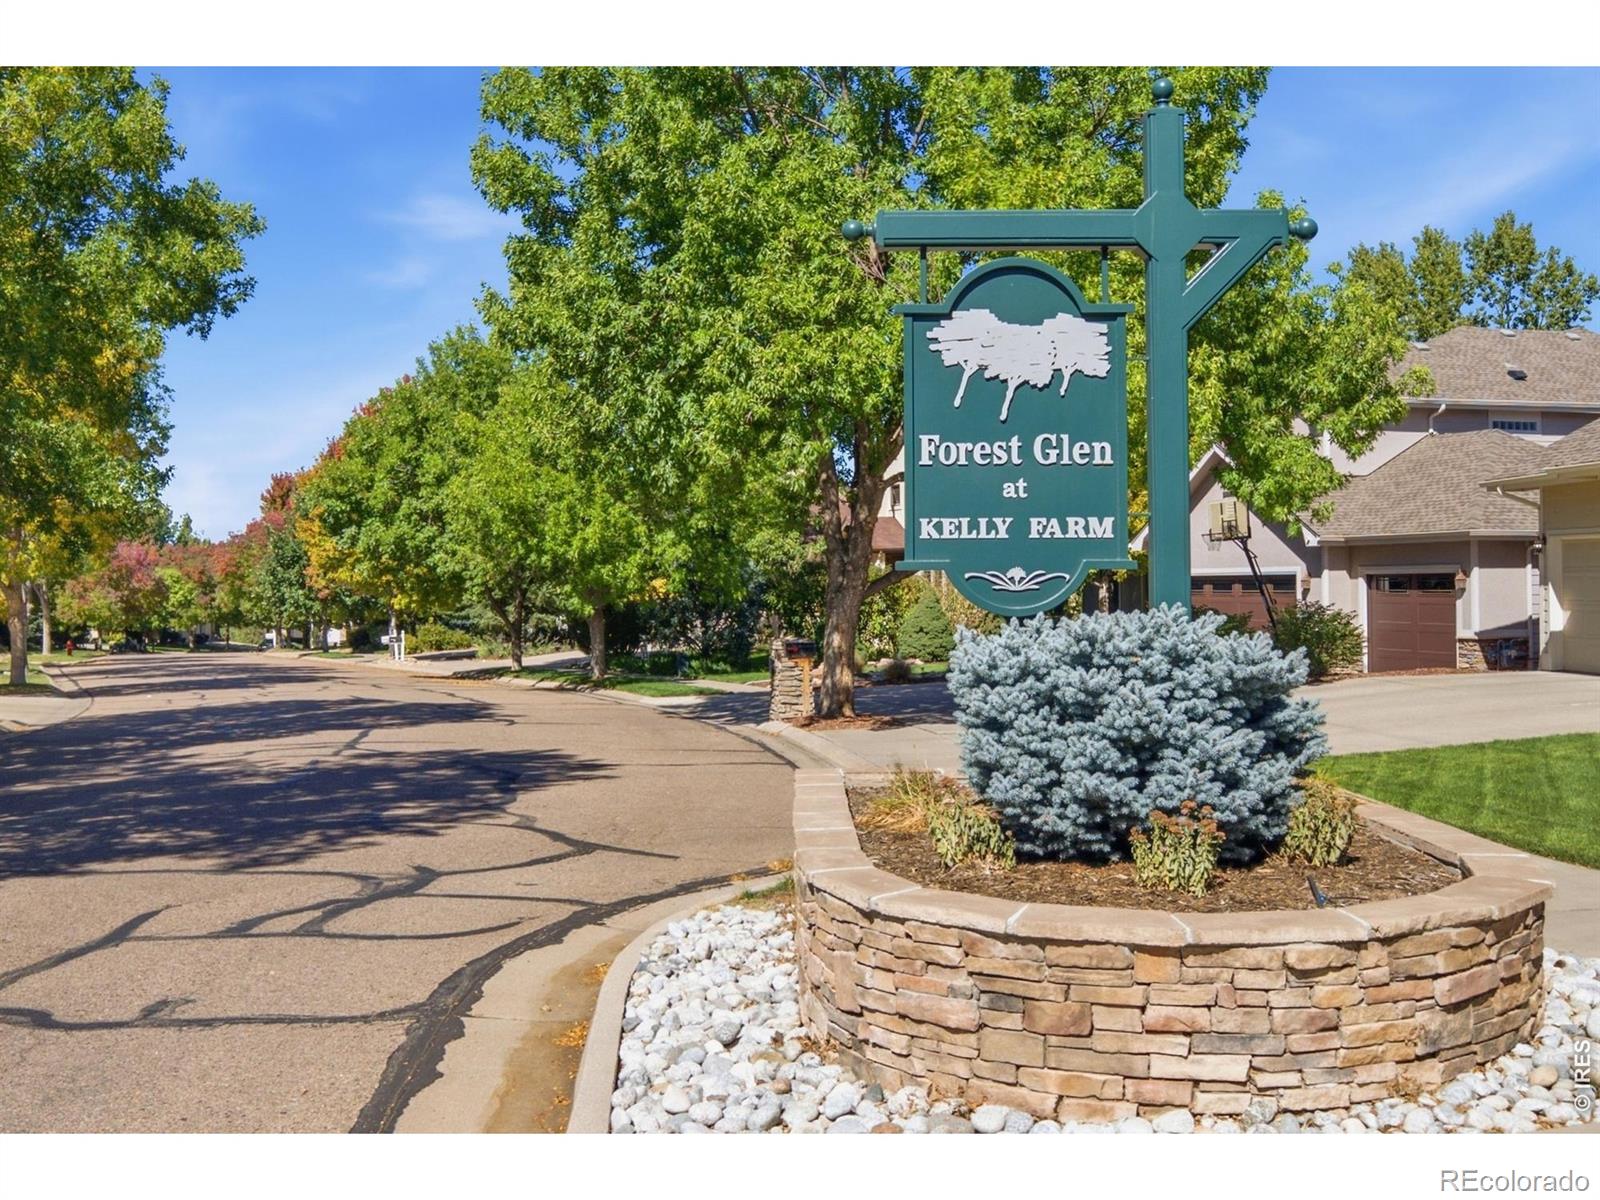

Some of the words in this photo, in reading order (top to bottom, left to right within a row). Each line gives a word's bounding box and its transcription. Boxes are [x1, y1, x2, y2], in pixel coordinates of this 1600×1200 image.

[918, 434, 1023, 465] Forest
[1033, 433, 1114, 465] Glen
[1002, 477, 1028, 498] at
[919, 517, 1014, 539] KELLY
[1028, 516, 1115, 539] FARM
